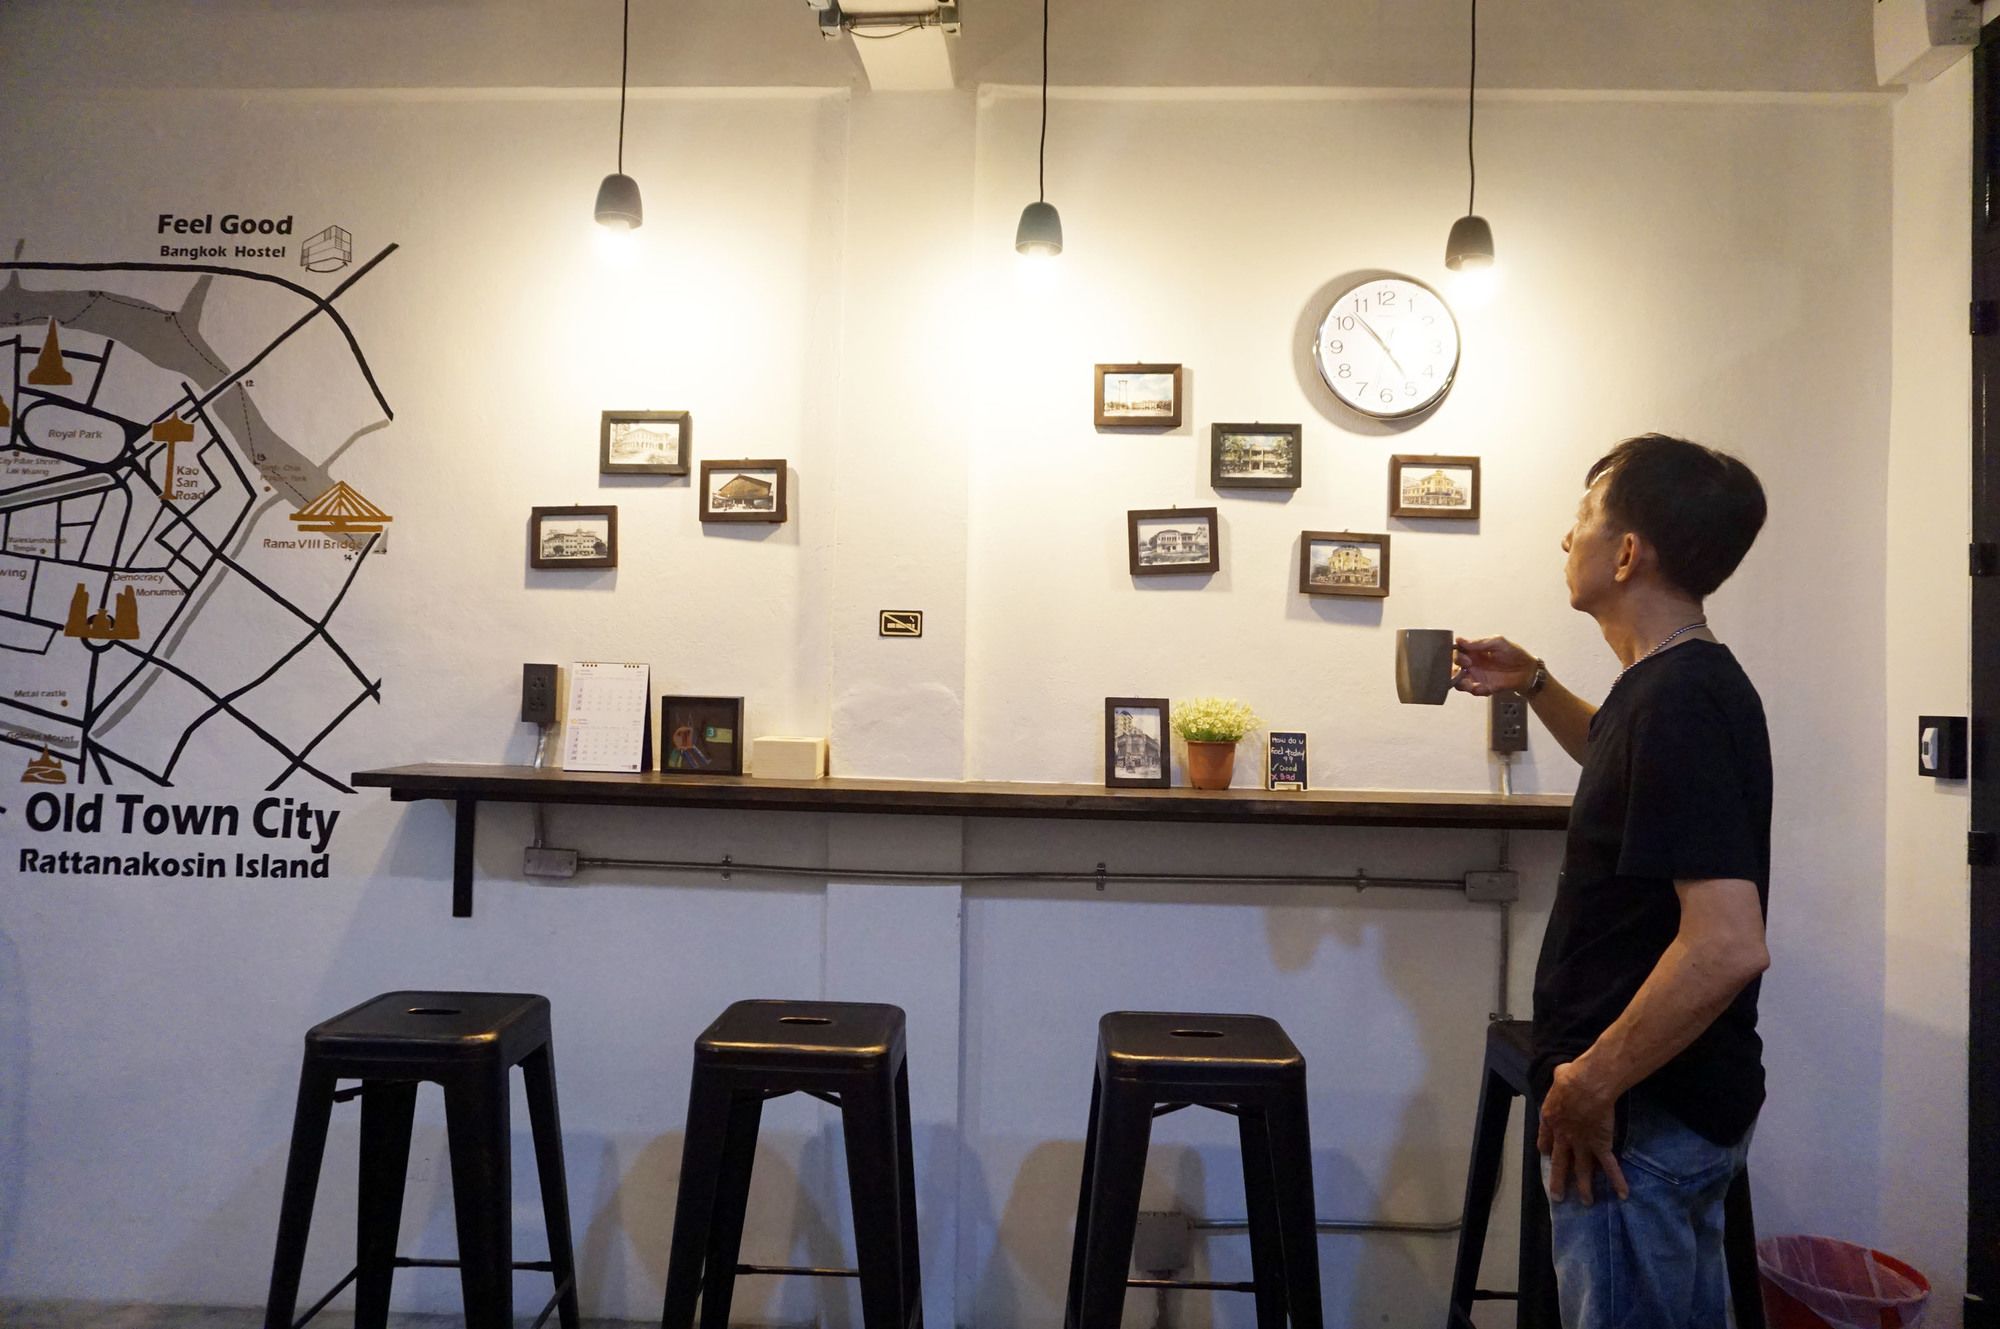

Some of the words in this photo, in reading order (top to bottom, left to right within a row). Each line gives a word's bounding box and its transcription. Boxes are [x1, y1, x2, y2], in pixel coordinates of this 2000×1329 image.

[157, 214, 212, 234] Feel
[220, 214, 293, 234] Good
[160, 245, 226, 260] Bangkok
[235, 246, 286, 258] Hostel
[1354, 298, 1368, 312] 11
[1377, 290, 1396, 306] 12
[1336, 316, 1354, 330] 10
[1330, 340, 1344, 354] 9
[1338, 363, 1352, 378] 8
[1421, 364, 1434, 378] 4
[1356, 382, 1368, 396] 7
[1380, 388, 1393, 403] 6
[1404, 382, 1417, 396] 5
[48, 429, 76, 438] Royal
[78, 430, 102, 438] Park
[176, 466, 200, 476] Kao
[176, 478, 198, 488] San
[176, 490, 206, 500] Road
[263, 538, 296, 549] Rama
[298, 538, 320, 549] VIII
[324, 538, 364, 551] Bridge
[113, 573, 164, 583] Democracy
[136, 588, 185, 596] Monument
[14, 690, 40, 698] Metal
[1288, 736, 1297, 744] do
[1285, 748, 1305, 760] today
[26, 791, 104, 833] Old
[116, 794, 240, 836] Town
[252, 797, 340, 854] City
[20, 848, 226, 878] Rattanakosin
[236, 853, 330, 878] Island
